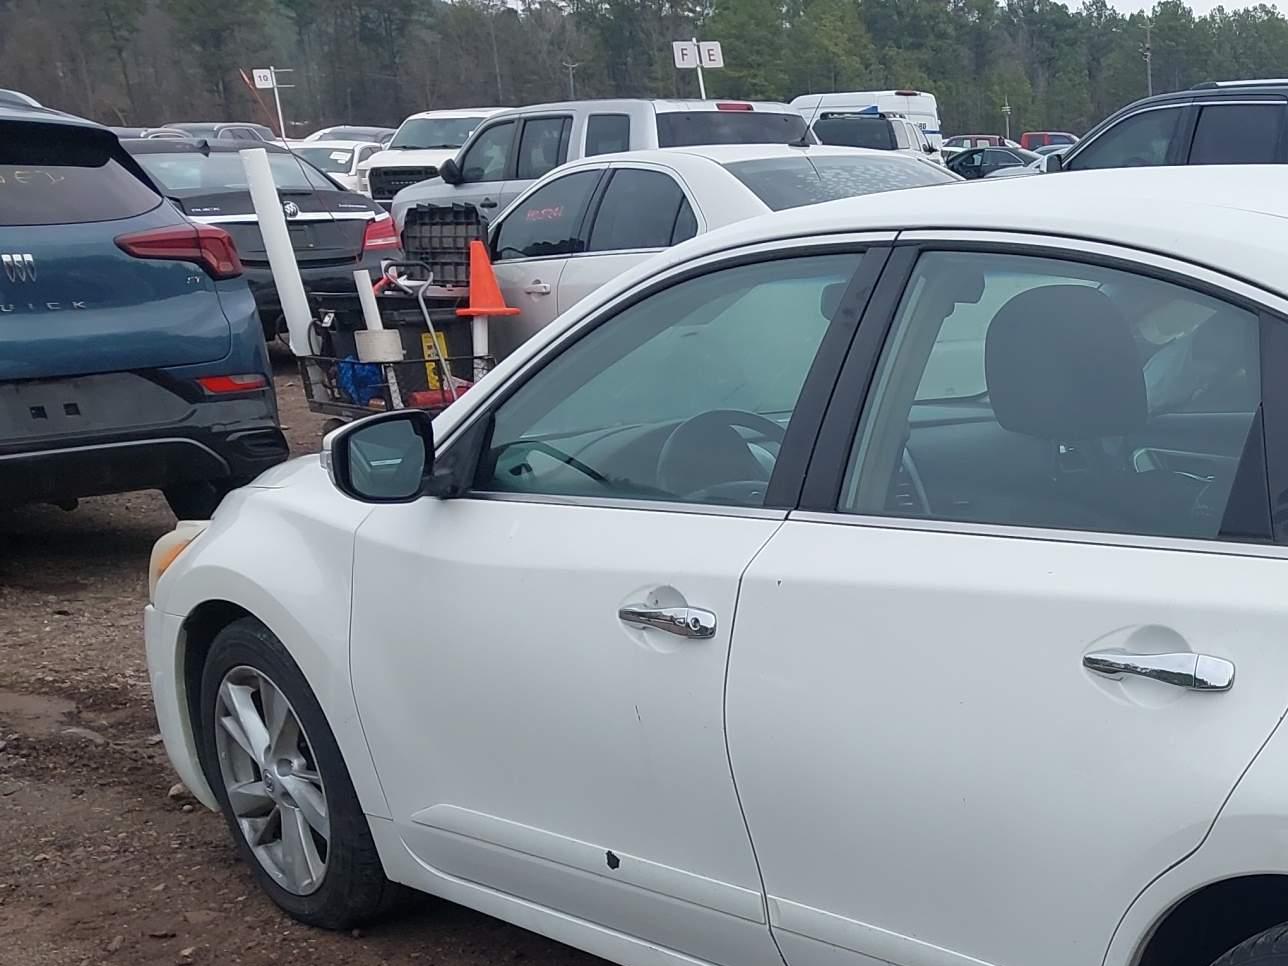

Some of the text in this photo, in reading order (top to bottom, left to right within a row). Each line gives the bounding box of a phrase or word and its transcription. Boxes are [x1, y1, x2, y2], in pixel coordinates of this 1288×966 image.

[680, 47, 688, 62] F
[707, 48, 716, 62] E
[0, 300, 87, 312] UICK
